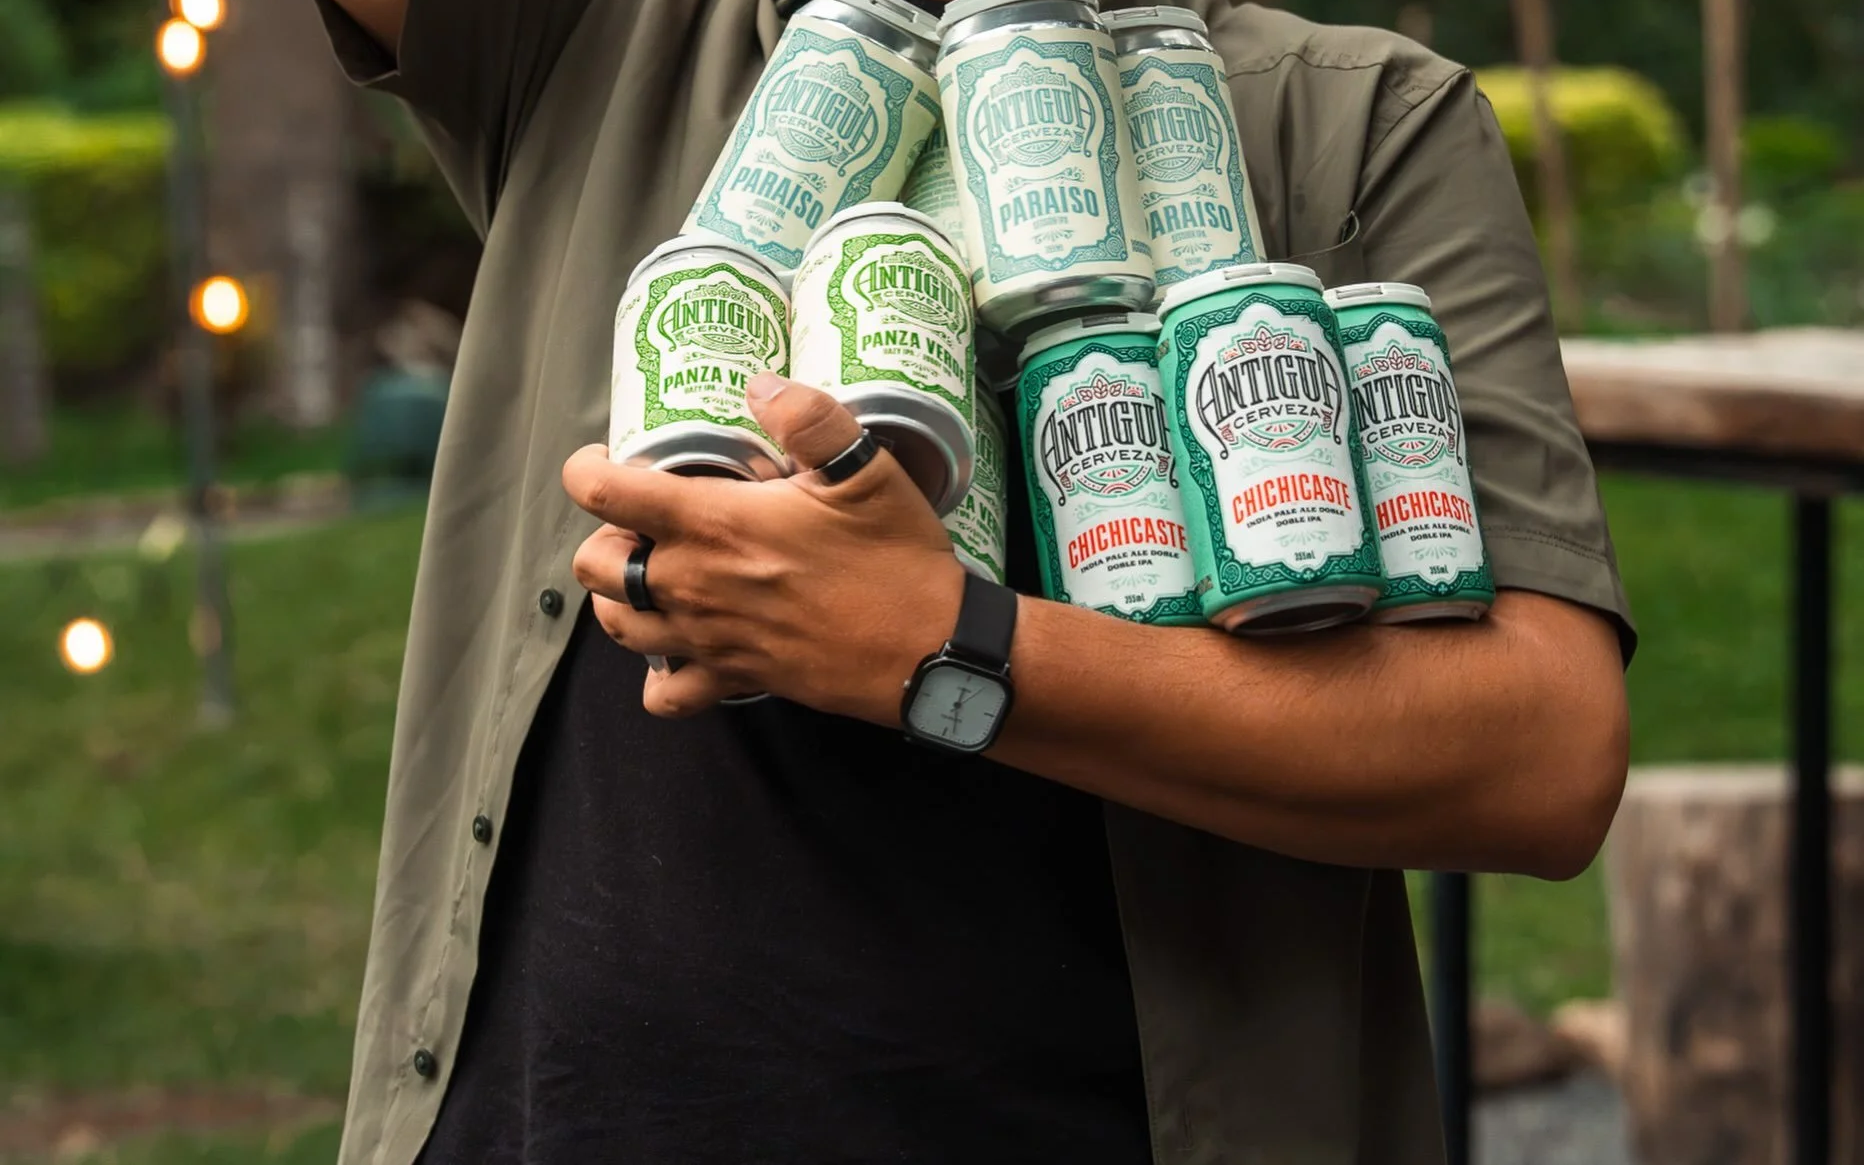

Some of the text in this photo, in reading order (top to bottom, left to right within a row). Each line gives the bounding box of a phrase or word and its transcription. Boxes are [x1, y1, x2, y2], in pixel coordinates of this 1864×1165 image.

[757, 70, 879, 178] ANTIGUA
[778, 114, 841, 153] CERVEZA
[974, 81, 1096, 174] ANTIGUA
[1001, 127, 1073, 149] CERVEZA
[1127, 100, 1223, 176] NTIGUA
[1135, 144, 1205, 165] CERVEZA
[1146, 196, 1233, 241] ARAÍSO
[862, 330, 921, 351] PANZA
[664, 366, 722, 394] PANZA
[1196, 348, 1342, 460] ANTIGUA
[1234, 404, 1321, 429] CERVEZA
[1352, 369, 1463, 467] NTIGUA
[1367, 422, 1447, 444] CERVEZA
[1070, 449, 1155, 476] CERVEZA
[1232, 473, 1352, 525] CHICHICASTE
[1376, 491, 1475, 531] HICHICASTE
[1247, 506, 1346, 528] INDIA PALE ALE DOBLE
[1276, 515, 1322, 528] DOBLE IPA
[1068, 517, 1188, 569] CHICHICASTE
[1381, 528, 1406, 543] INDIA
[1408, 523, 1430, 533] PALE
[1449, 523, 1471, 535] DOBLE
[1411, 532, 1438, 542] DOBLE
[1080, 550, 1180, 573] INDIA PALE ALE DOBLE
[1107, 558, 1153, 572] DOBLE IPA
